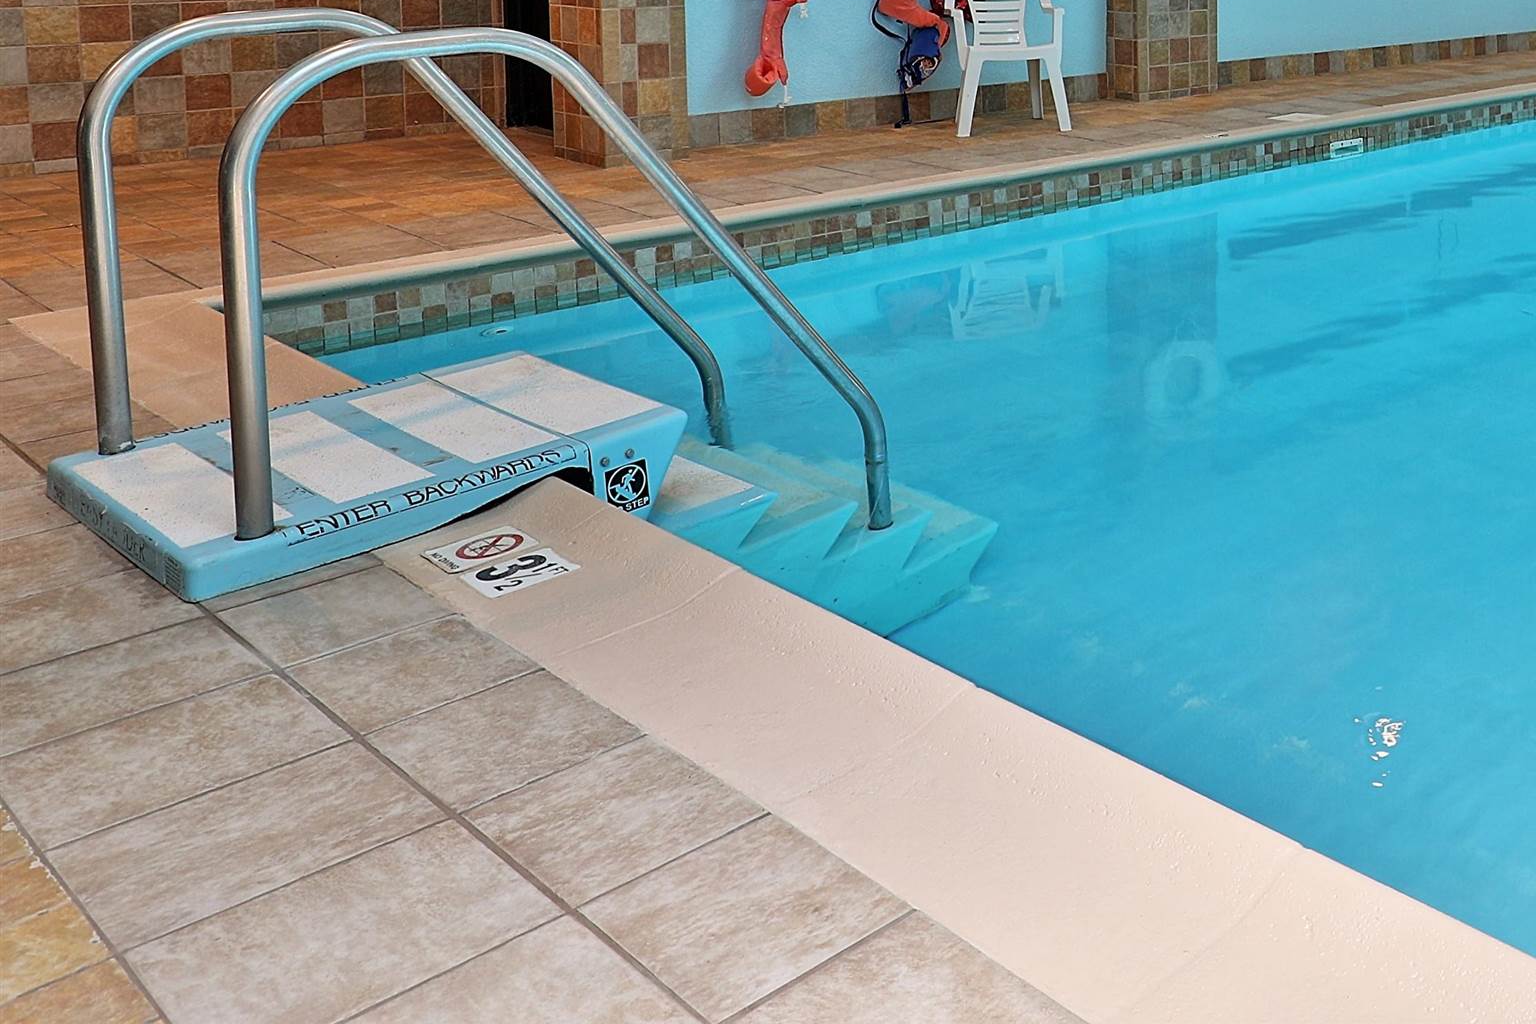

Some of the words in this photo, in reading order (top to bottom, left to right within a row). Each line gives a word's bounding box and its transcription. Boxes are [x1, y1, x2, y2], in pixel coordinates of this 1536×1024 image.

[299, 500, 392, 538] ENTER
[403, 450, 560, 506] BACKWARDS
[626, 496, 649, 511] STEP
[438, 557, 460, 570] DIVING
[475, 554, 547, 581] 3
